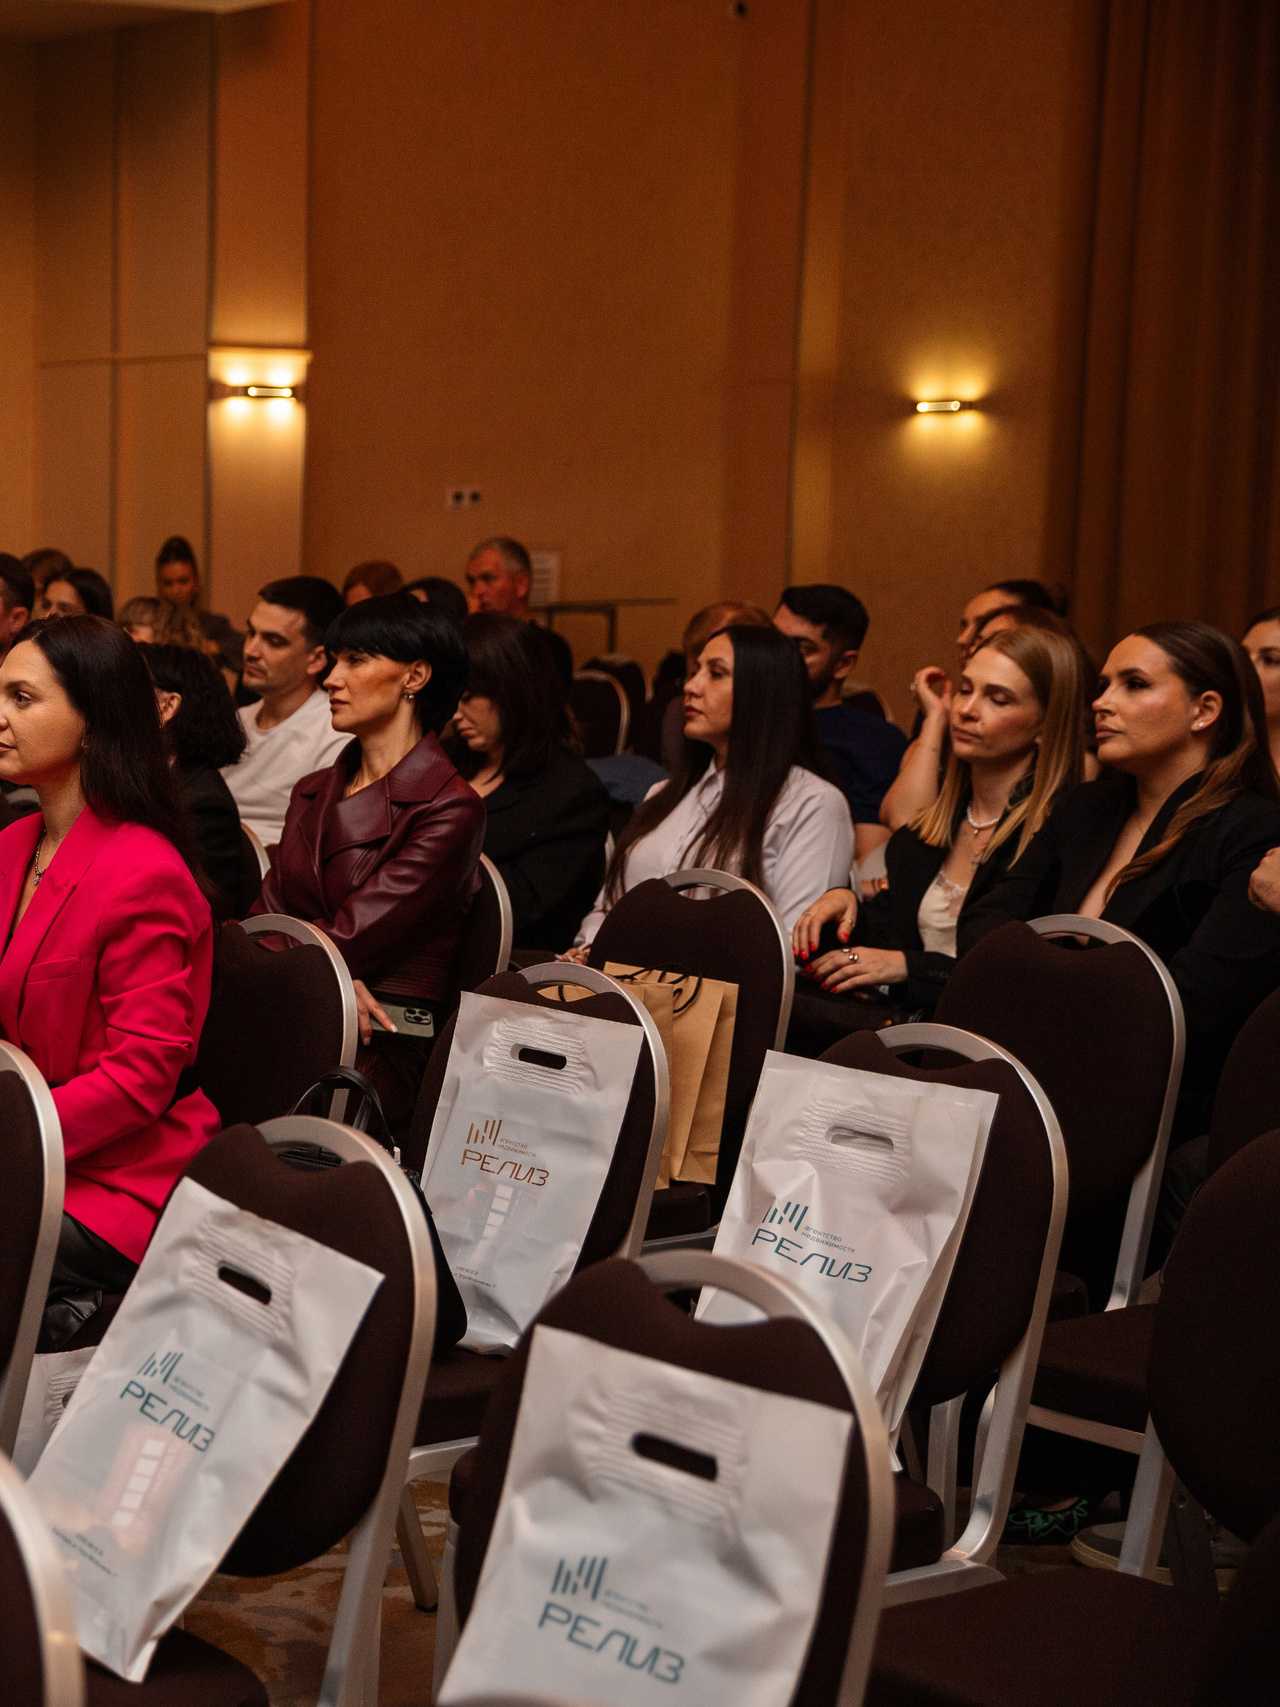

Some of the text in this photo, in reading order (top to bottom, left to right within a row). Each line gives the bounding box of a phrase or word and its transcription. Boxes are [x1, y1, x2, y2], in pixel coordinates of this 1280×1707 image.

[460, 1148, 550, 1187] РЕЛИЗ
[751, 1228, 873, 1283] РЕЛИЗ
[801, 1231, 855, 1253] недвижимости
[804, 1225, 842, 1242] агентство
[119, 1380, 216, 1452] РЕЛИЗ
[537, 1601, 686, 1685] РЕЛИЗ
